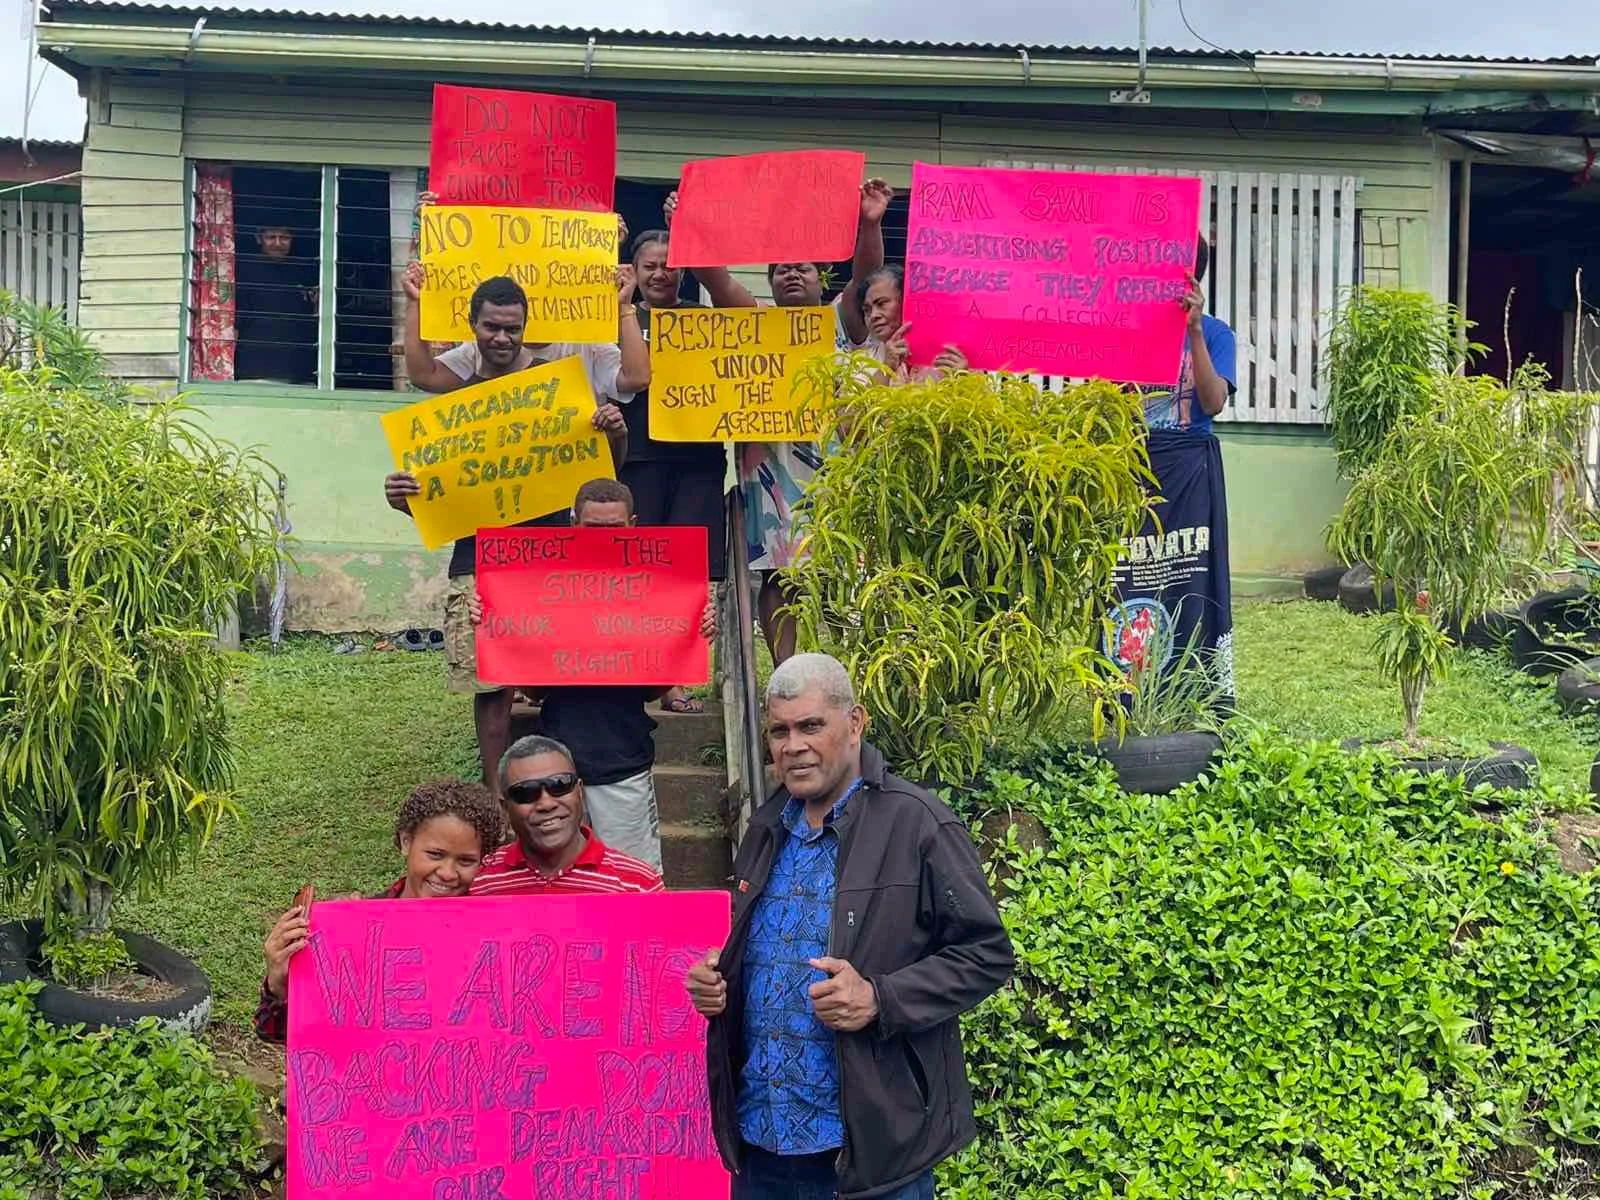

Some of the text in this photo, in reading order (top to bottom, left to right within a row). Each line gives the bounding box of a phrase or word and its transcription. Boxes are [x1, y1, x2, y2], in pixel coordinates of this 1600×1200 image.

[463, 95, 597, 141] DO NOT
[541, 145, 585, 177] THE
[446, 173, 520, 200] UNION
[917, 181, 993, 222] RAM
[1131, 192, 1170, 224] IS
[423, 213, 617, 255] NO TO TEMPORARY
[913, 227, 1194, 267] ADVERTISING POSITION
[425, 262, 482, 291] FIXES
[909, 261, 1012, 294] BECAUSE
[1040, 272, 1107, 306] THEY
[966, 299, 985, 320] A
[655, 309, 823, 353] RESPECT THE
[711, 353, 787, 380] UNION
[410, 377, 560, 440] A VACANCY
[660, 380, 774, 410] SIGN THE
[403, 407, 578, 471] NOTICE IS NOT
[426, 437, 600, 501] A SOLUTION
[494, 485, 523, 519] !!
[480, 535, 673, 567] RESPECT THE
[592, 613, 690, 638] WORKERS
[552, 648, 635, 677] RIGHT
[309, 920, 432, 1031] WE
[447, 933, 603, 1038] ARE
[291, 1037, 547, 1125] BACKING
[302, 1106, 719, 1189] WE ARE DEMANDIN
[433, 1165, 507, 1200] OUR
